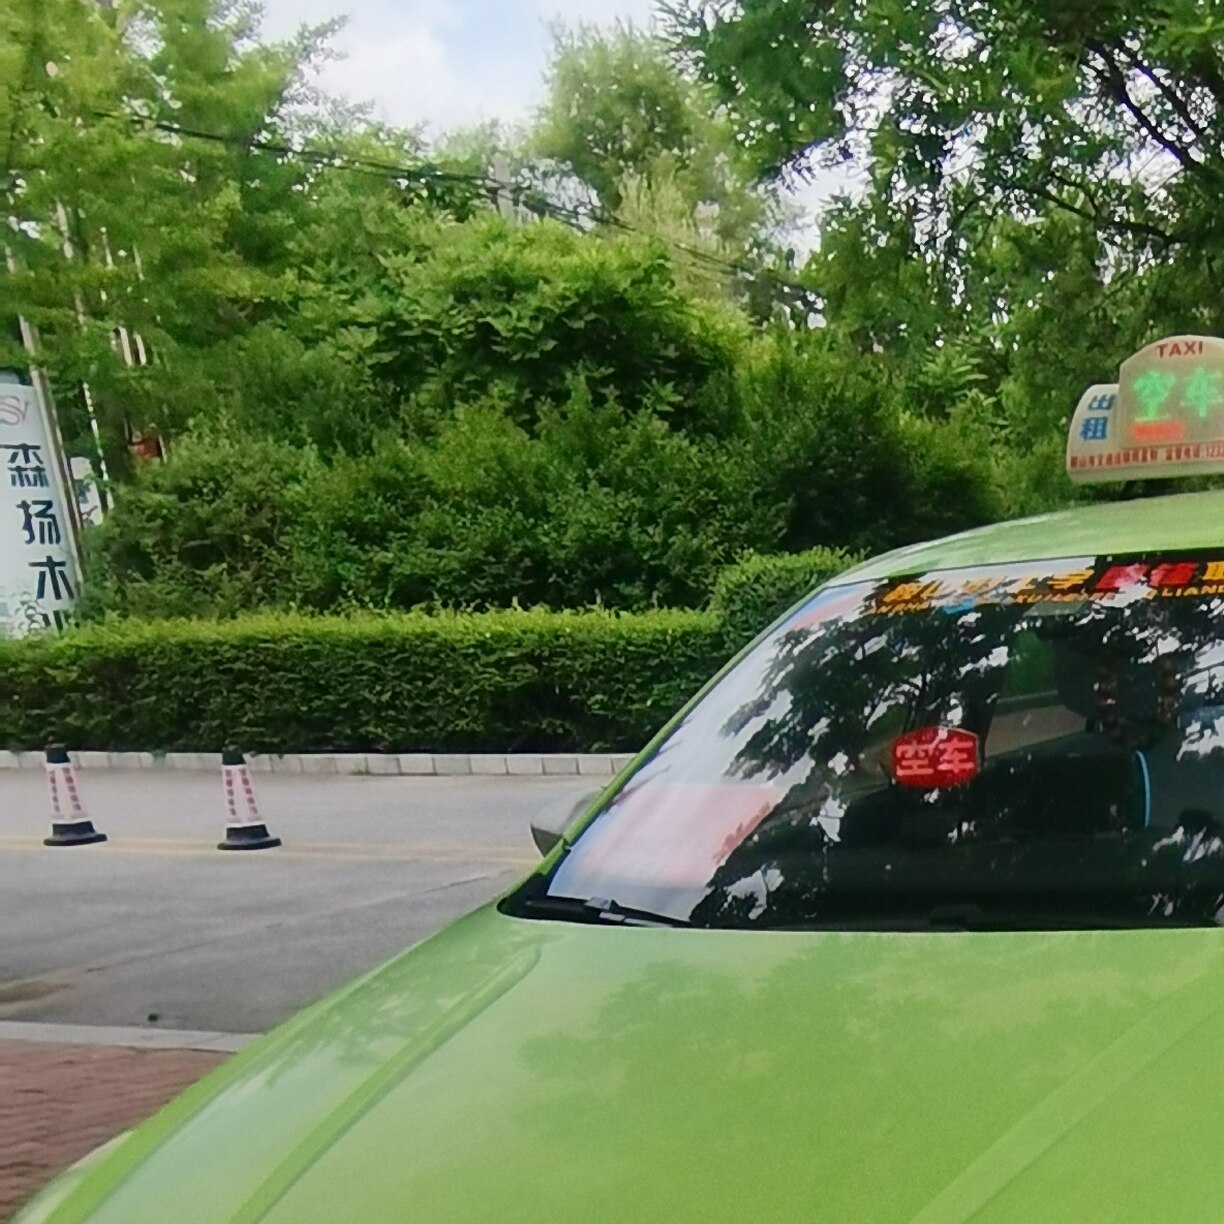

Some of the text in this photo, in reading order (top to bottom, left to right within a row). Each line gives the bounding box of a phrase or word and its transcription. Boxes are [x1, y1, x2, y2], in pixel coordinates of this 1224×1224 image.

[1155, 341, 1204, 359] TAXI
[1080, 394, 1116, 442] 出租
[896, 738, 975, 777] 空车
